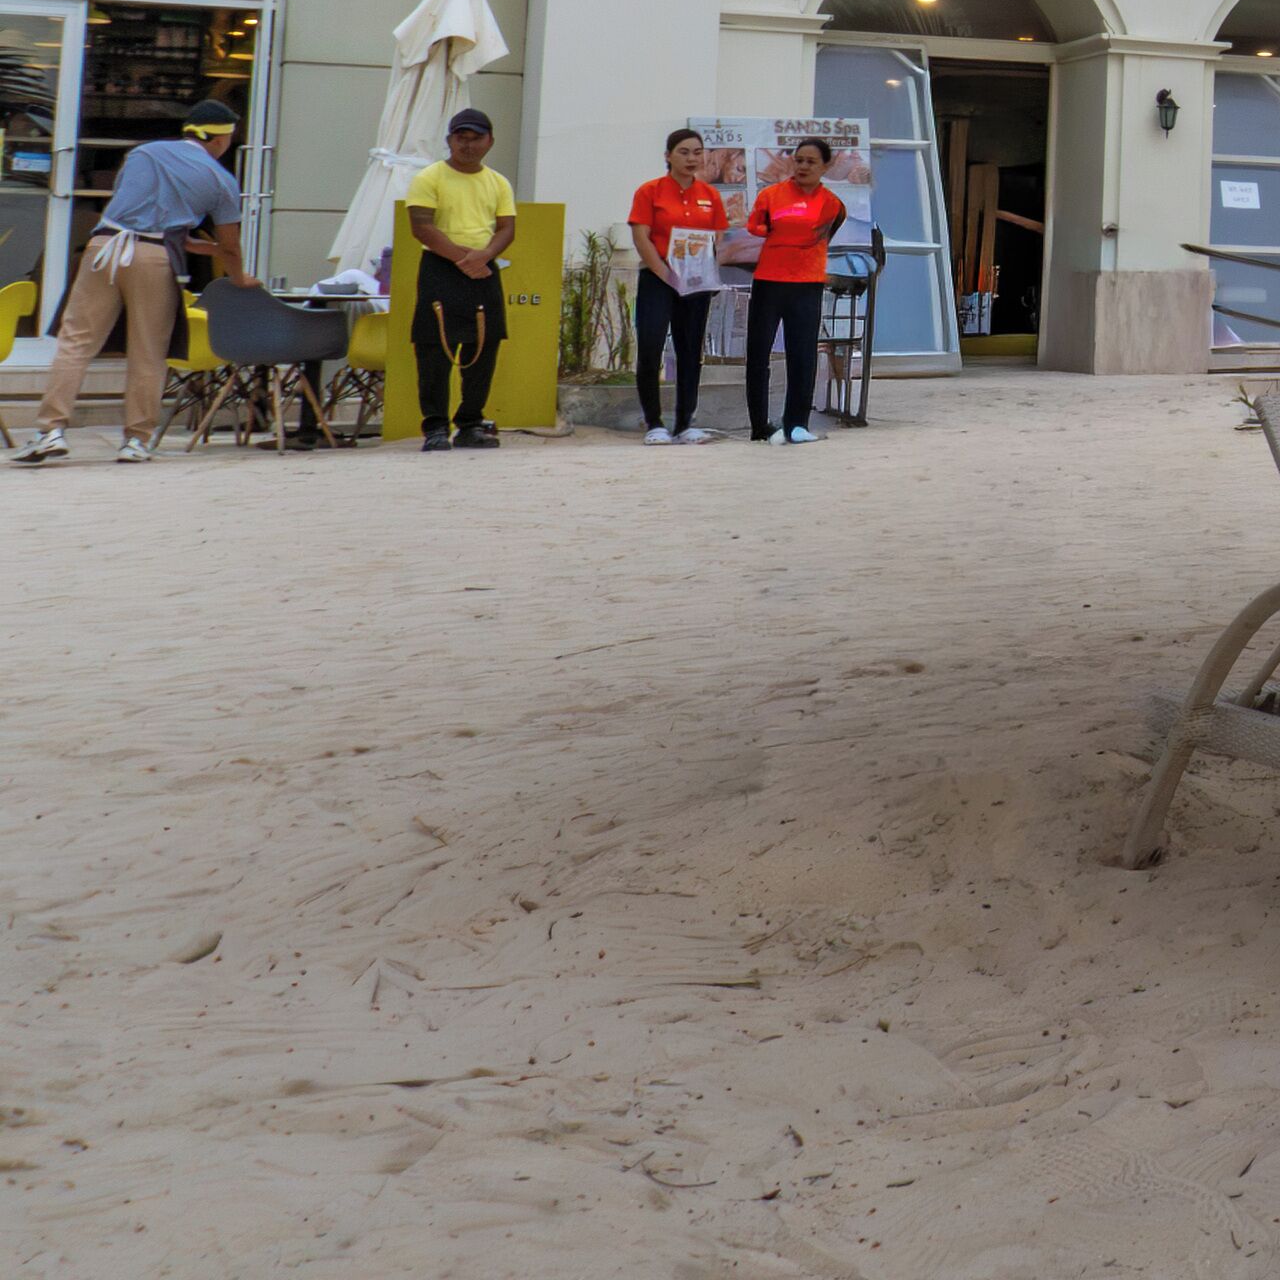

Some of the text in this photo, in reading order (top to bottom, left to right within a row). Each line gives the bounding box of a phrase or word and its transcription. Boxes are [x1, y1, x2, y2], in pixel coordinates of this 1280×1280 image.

[774, 118, 860, 137] SANDS Spa
[703, 133, 743, 142] ANDS
